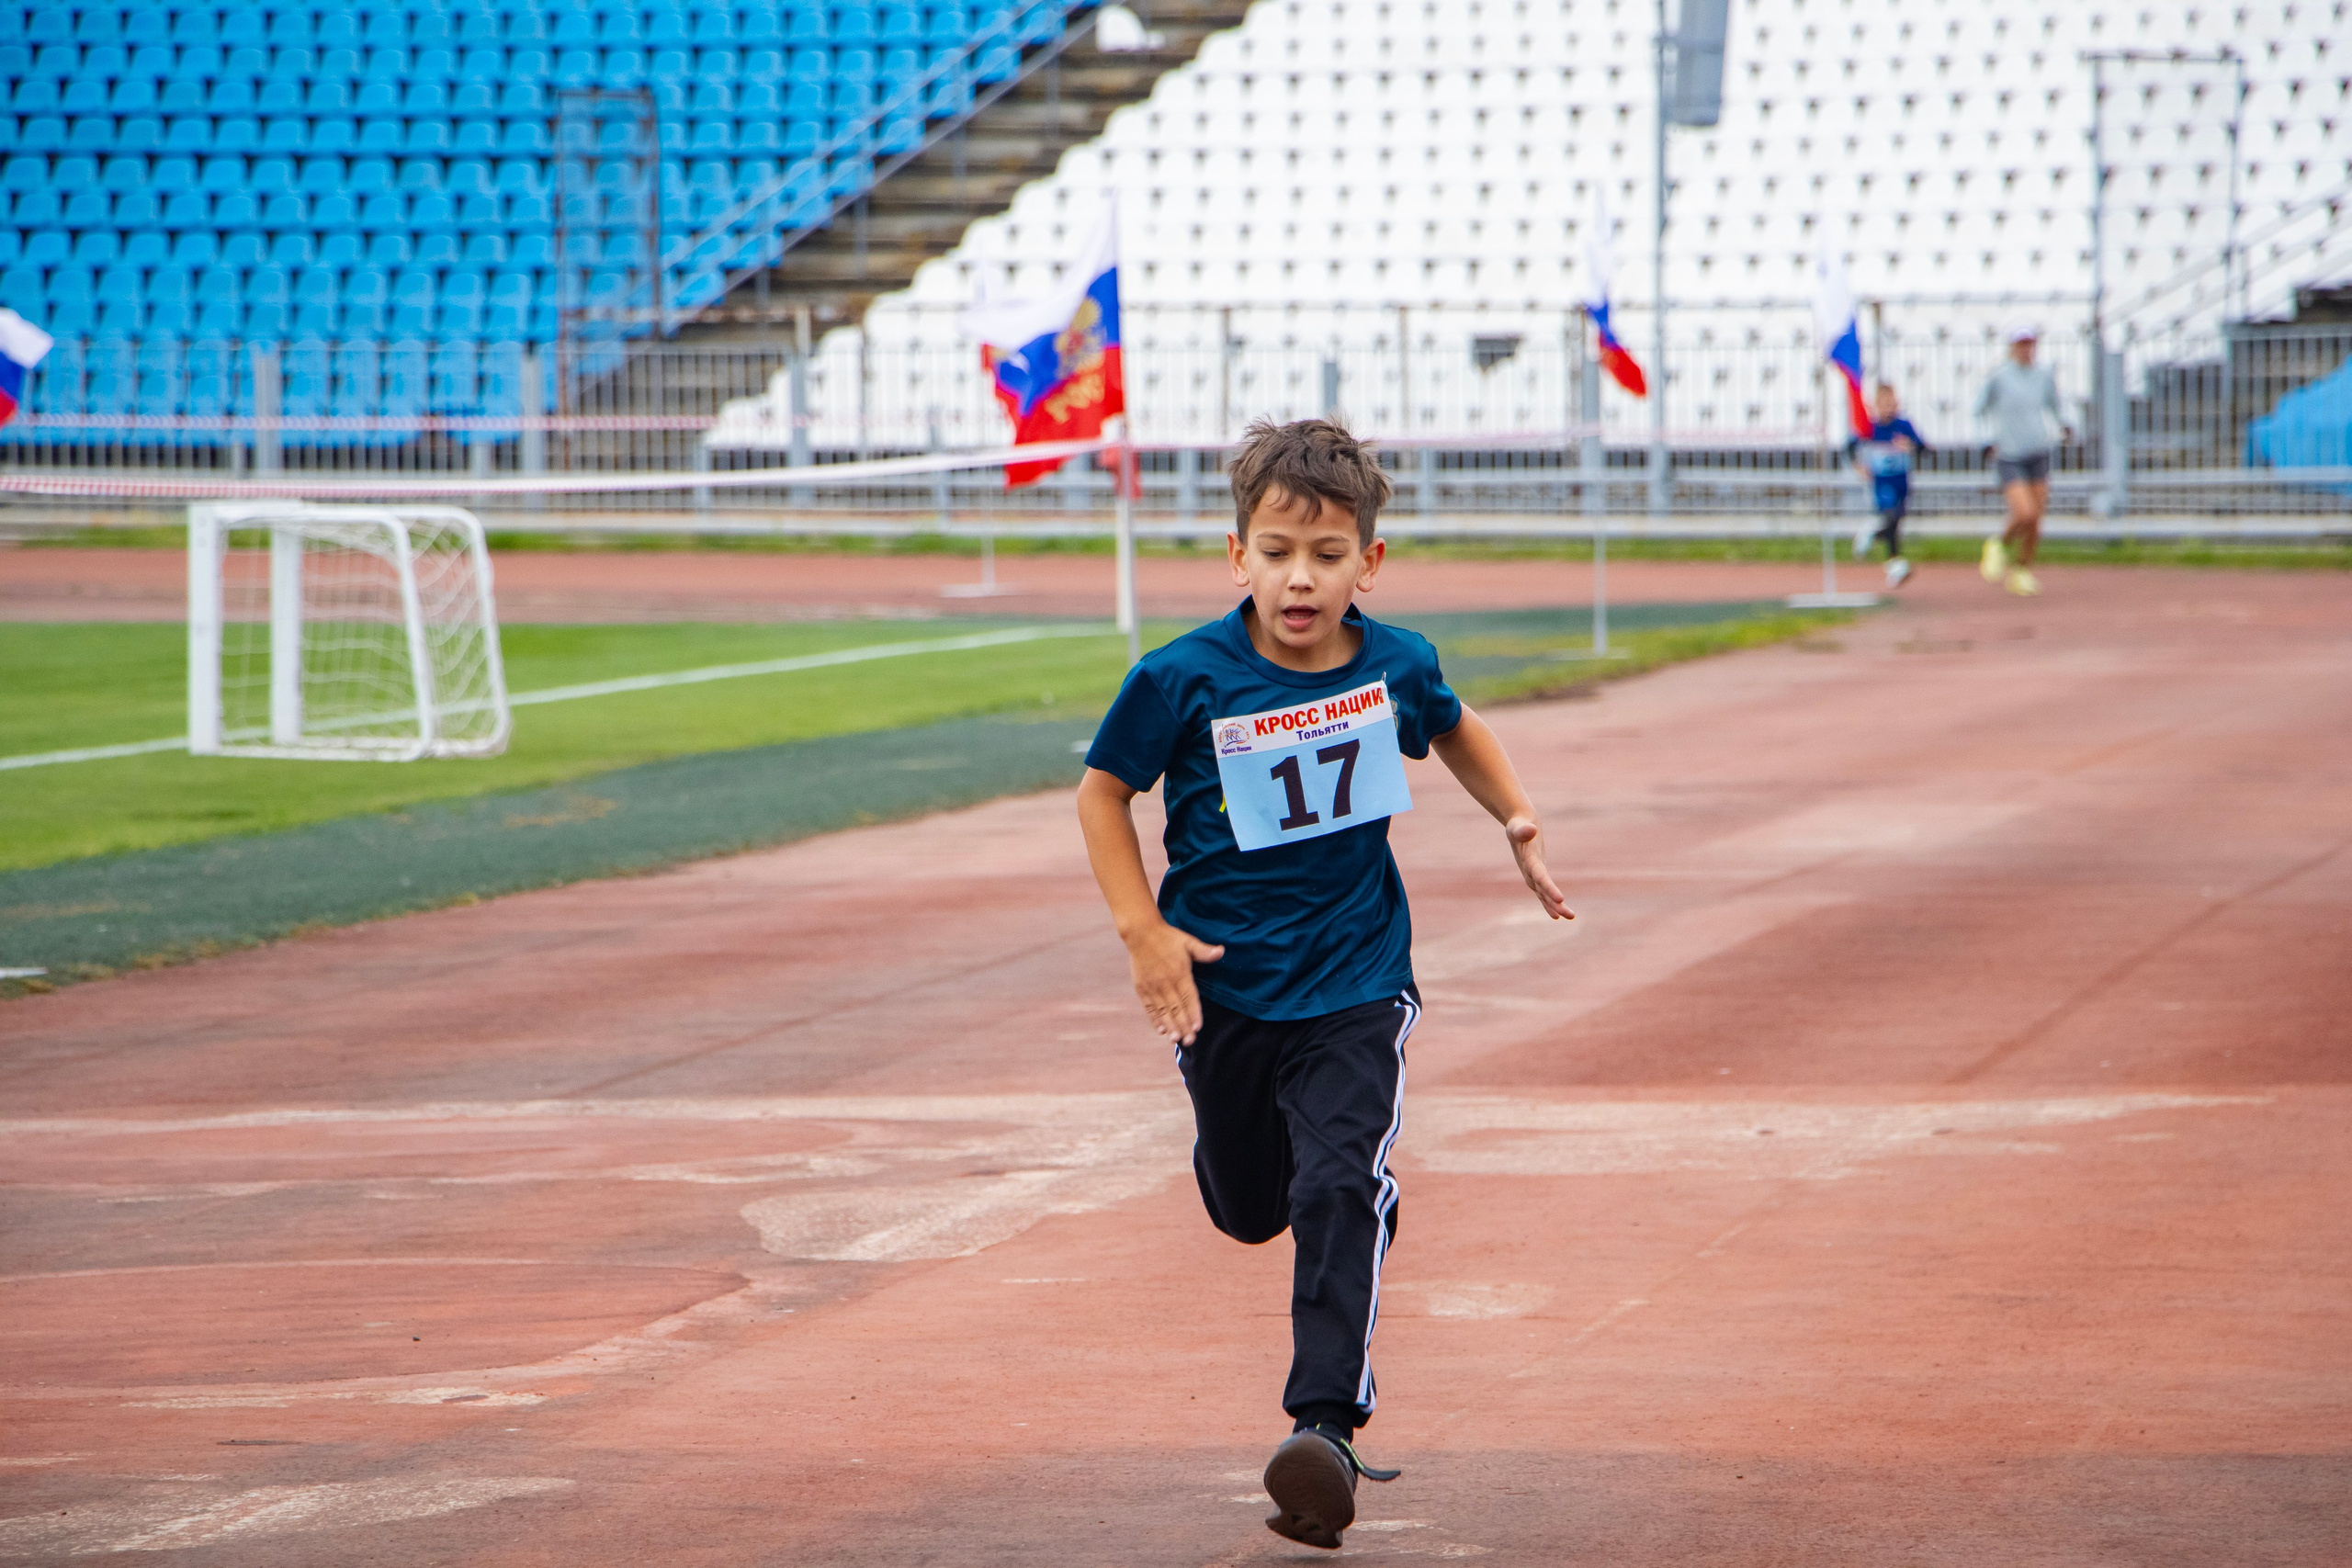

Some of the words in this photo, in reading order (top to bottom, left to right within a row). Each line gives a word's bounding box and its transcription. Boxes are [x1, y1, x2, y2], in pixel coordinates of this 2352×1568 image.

[1254, 707, 1319, 737] КРОСС
[1324, 687, 1385, 721] НАЦИИ
[1296, 721, 1349, 741] Тольятти
[1270, 738, 1361, 832] 17
